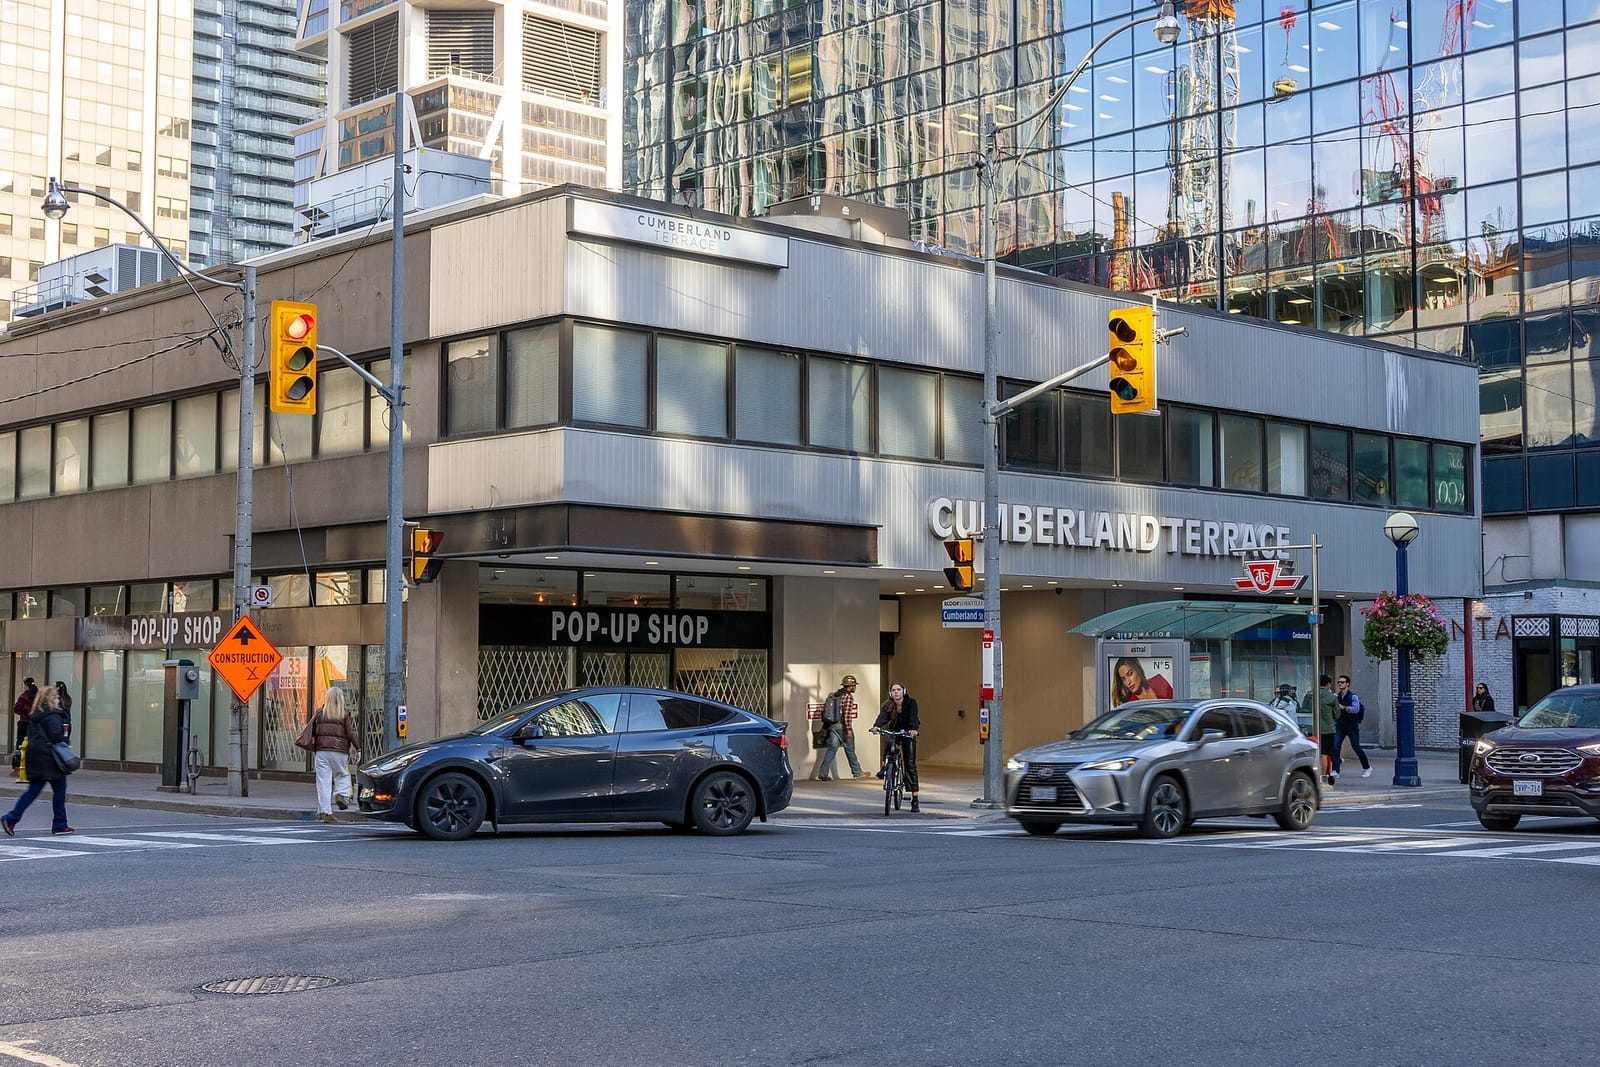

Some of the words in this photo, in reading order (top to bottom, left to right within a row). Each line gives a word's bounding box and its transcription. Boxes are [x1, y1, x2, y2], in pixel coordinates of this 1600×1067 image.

[637, 215, 731, 241] CUMBERLAND
[654, 229, 716, 250] TERRACE
[929, 497, 1160, 553] CUMBERLAND
[1161, 516, 1290, 559] TERRACE
[943, 610, 978, 620] Cumberland
[131, 617, 179, 645] POP-UP
[184, 616, 222, 645] SHOP
[552, 610, 640, 643] POP-UP
[648, 613, 709, 645] SHOP
[214, 652, 275, 664] CONSTRUCTION
[288, 658, 301, 675] 33
[280, 676, 291, 688] SITE
